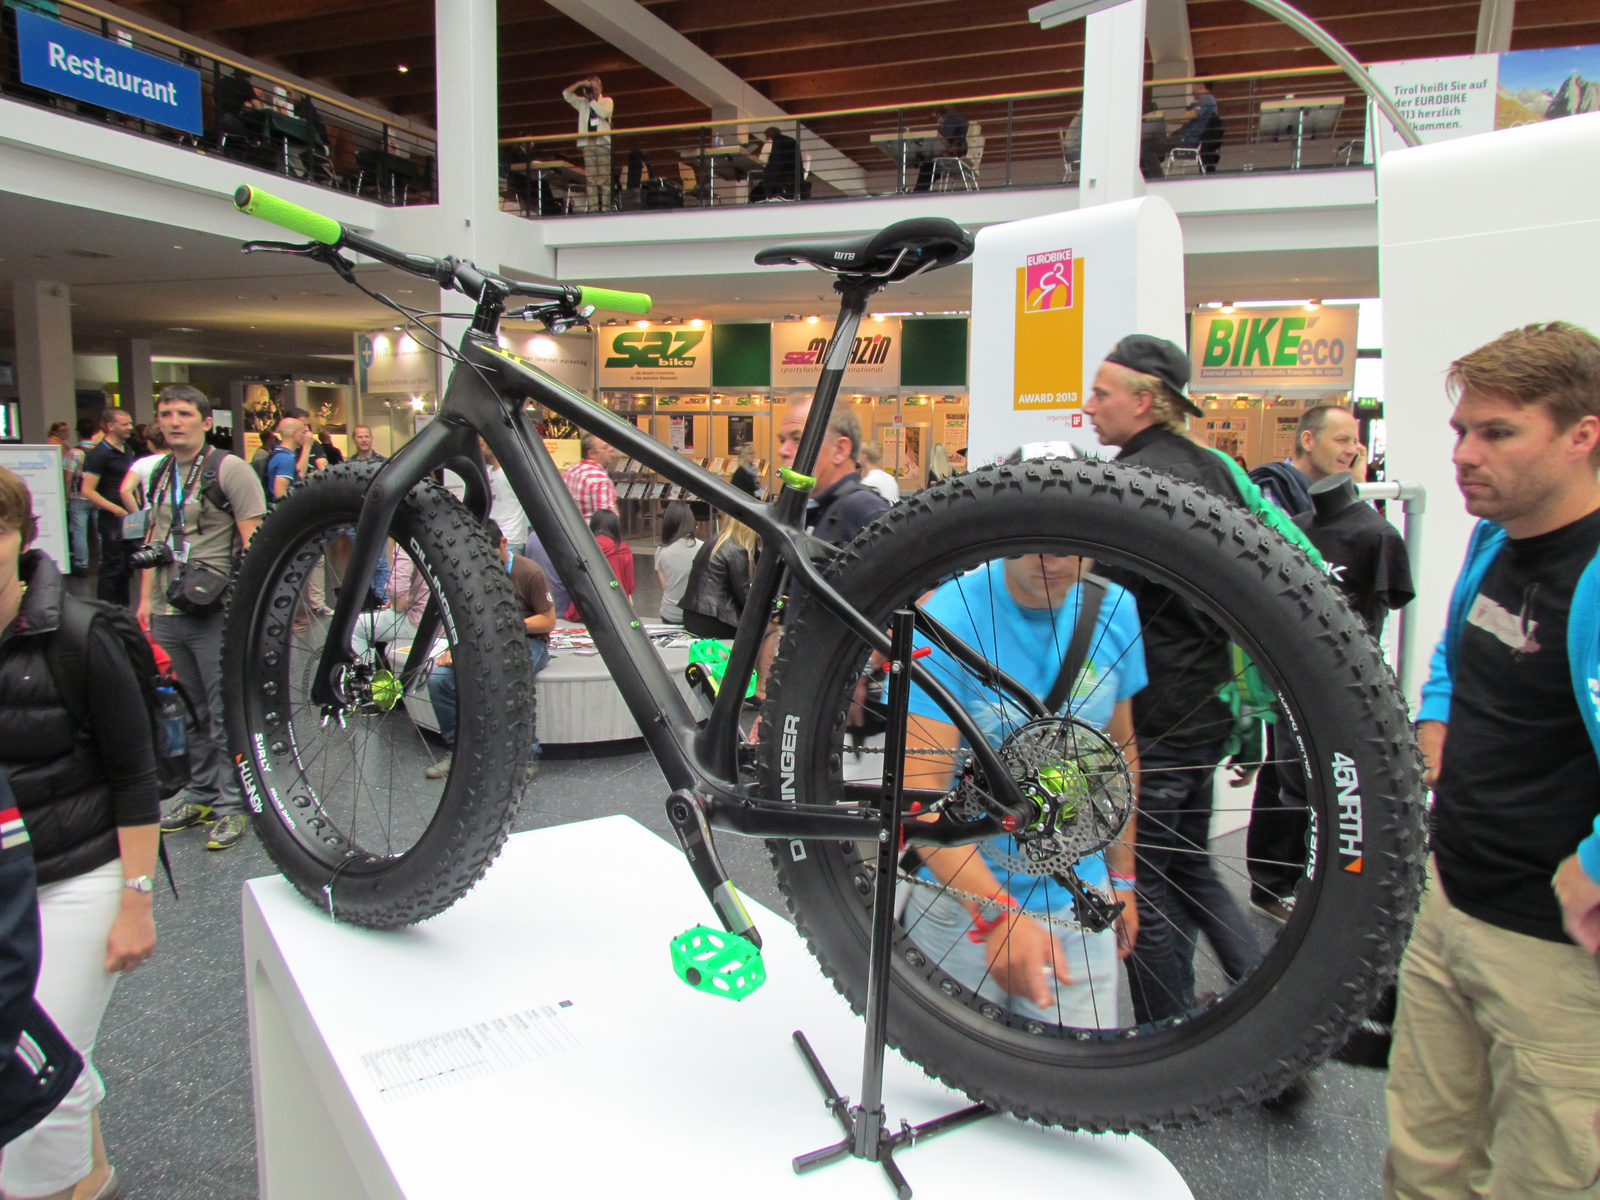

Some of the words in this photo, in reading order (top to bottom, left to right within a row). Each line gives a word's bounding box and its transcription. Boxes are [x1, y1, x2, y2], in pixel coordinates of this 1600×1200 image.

[48, 41, 178, 106] Restaurant
[1394, 84, 1418, 95] Tirol
[1420, 83, 1449, 93] heißt
[1450, 81, 1467, 91] Sie
[1469, 78, 1488, 89] auf
[1394, 98, 1413, 108] der
[1415, 93, 1467, 106] EUROBIKE
[1417, 106, 1461, 119] herzlich
[834, 251, 856, 260] WTB
[1027, 249, 1072, 266] EUROBIKE
[1202, 317, 1307, 366] BIKE
[658, 357, 694, 366] bike
[1226, 369, 1241, 378] pour
[1018, 393, 1054, 403] AWARD
[1056, 392, 1078, 402] 2013
[1046, 414, 1072, 422] organized
[410, 536, 459, 646] DILLINGER
[254, 733, 272, 772] SURLY
[1296, 735, 1313, 779] ROLLING
[1306, 805, 1318, 881] SURLY
